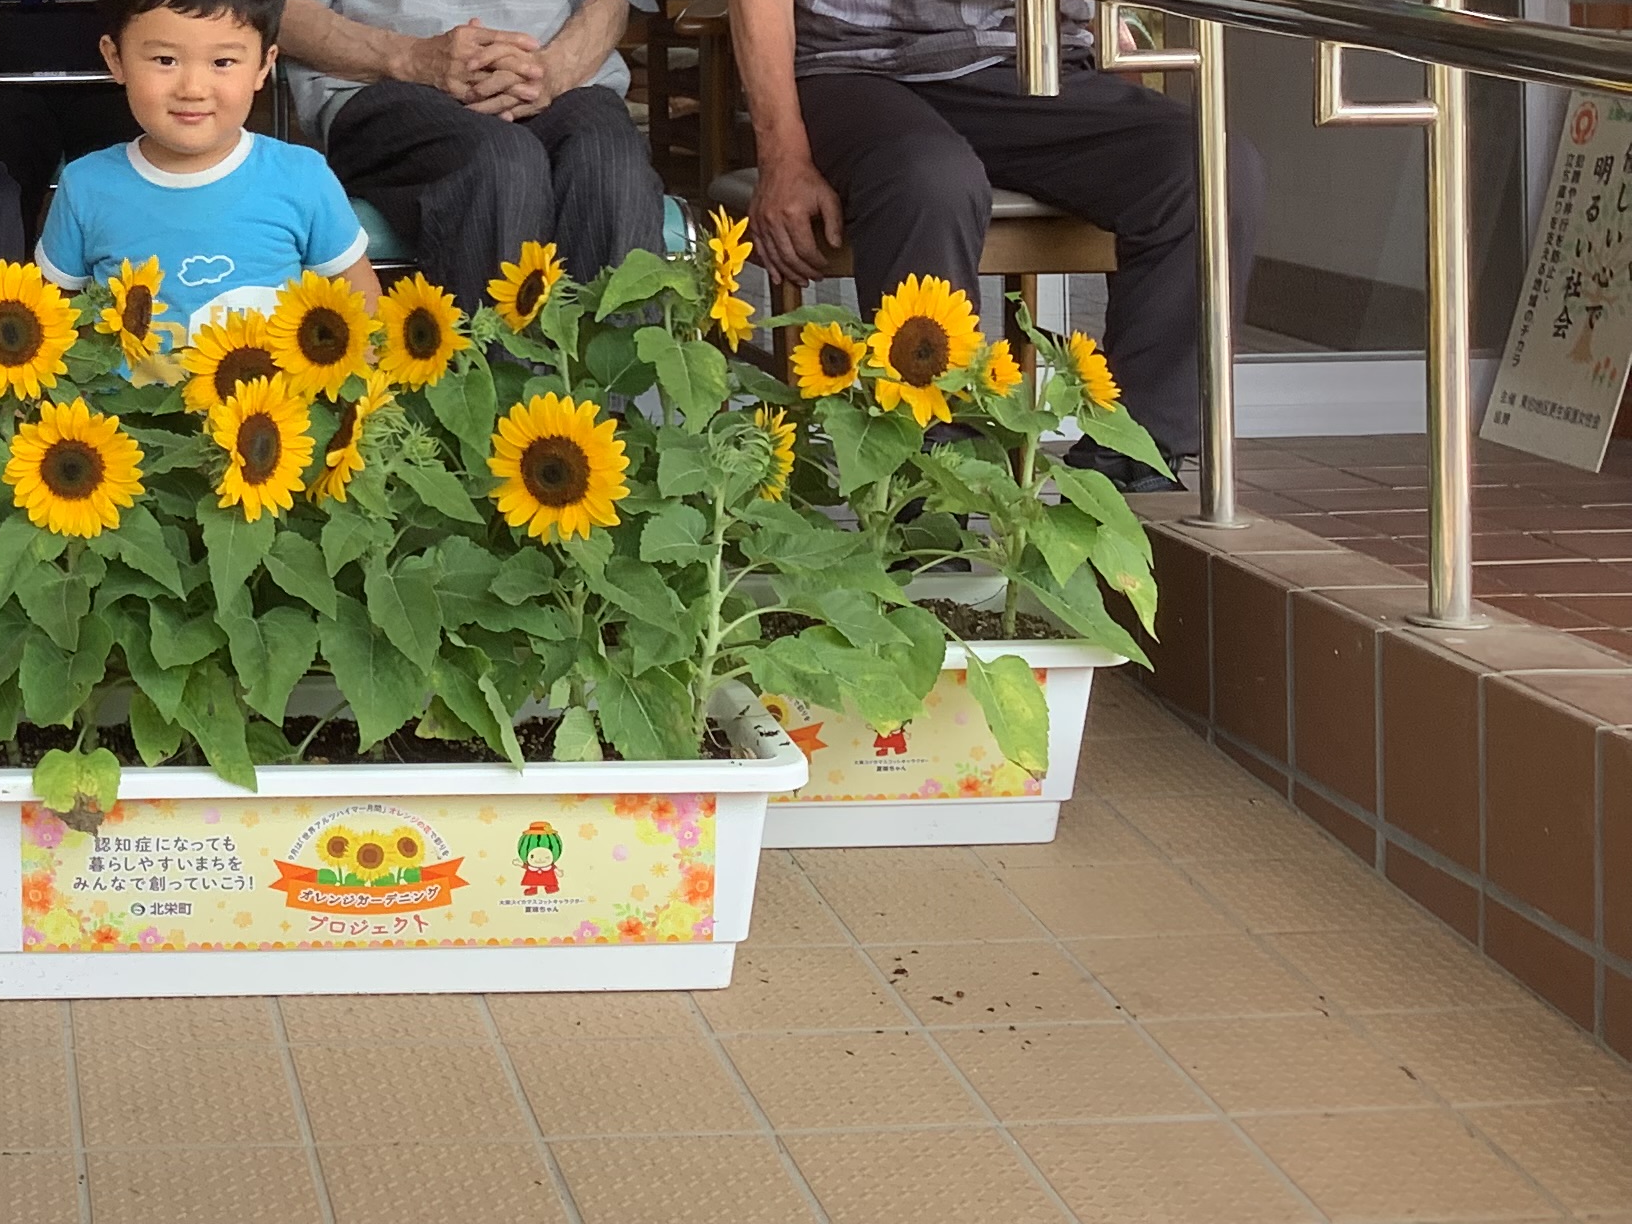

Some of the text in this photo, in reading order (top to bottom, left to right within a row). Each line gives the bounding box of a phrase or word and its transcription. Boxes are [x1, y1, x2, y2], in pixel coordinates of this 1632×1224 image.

[1553, 156, 1615, 339] 明るい社会
[94, 836, 236, 852] 認知症になっても
[88, 856, 243, 873] 暮らしやすいまちを
[73, 875, 254, 892] みんなで創っていこう！
[300, 886, 439, 906] オレンジガーデニング
[150, 902, 193, 915] 北栄町
[309, 914, 429, 935] プロジェクト
